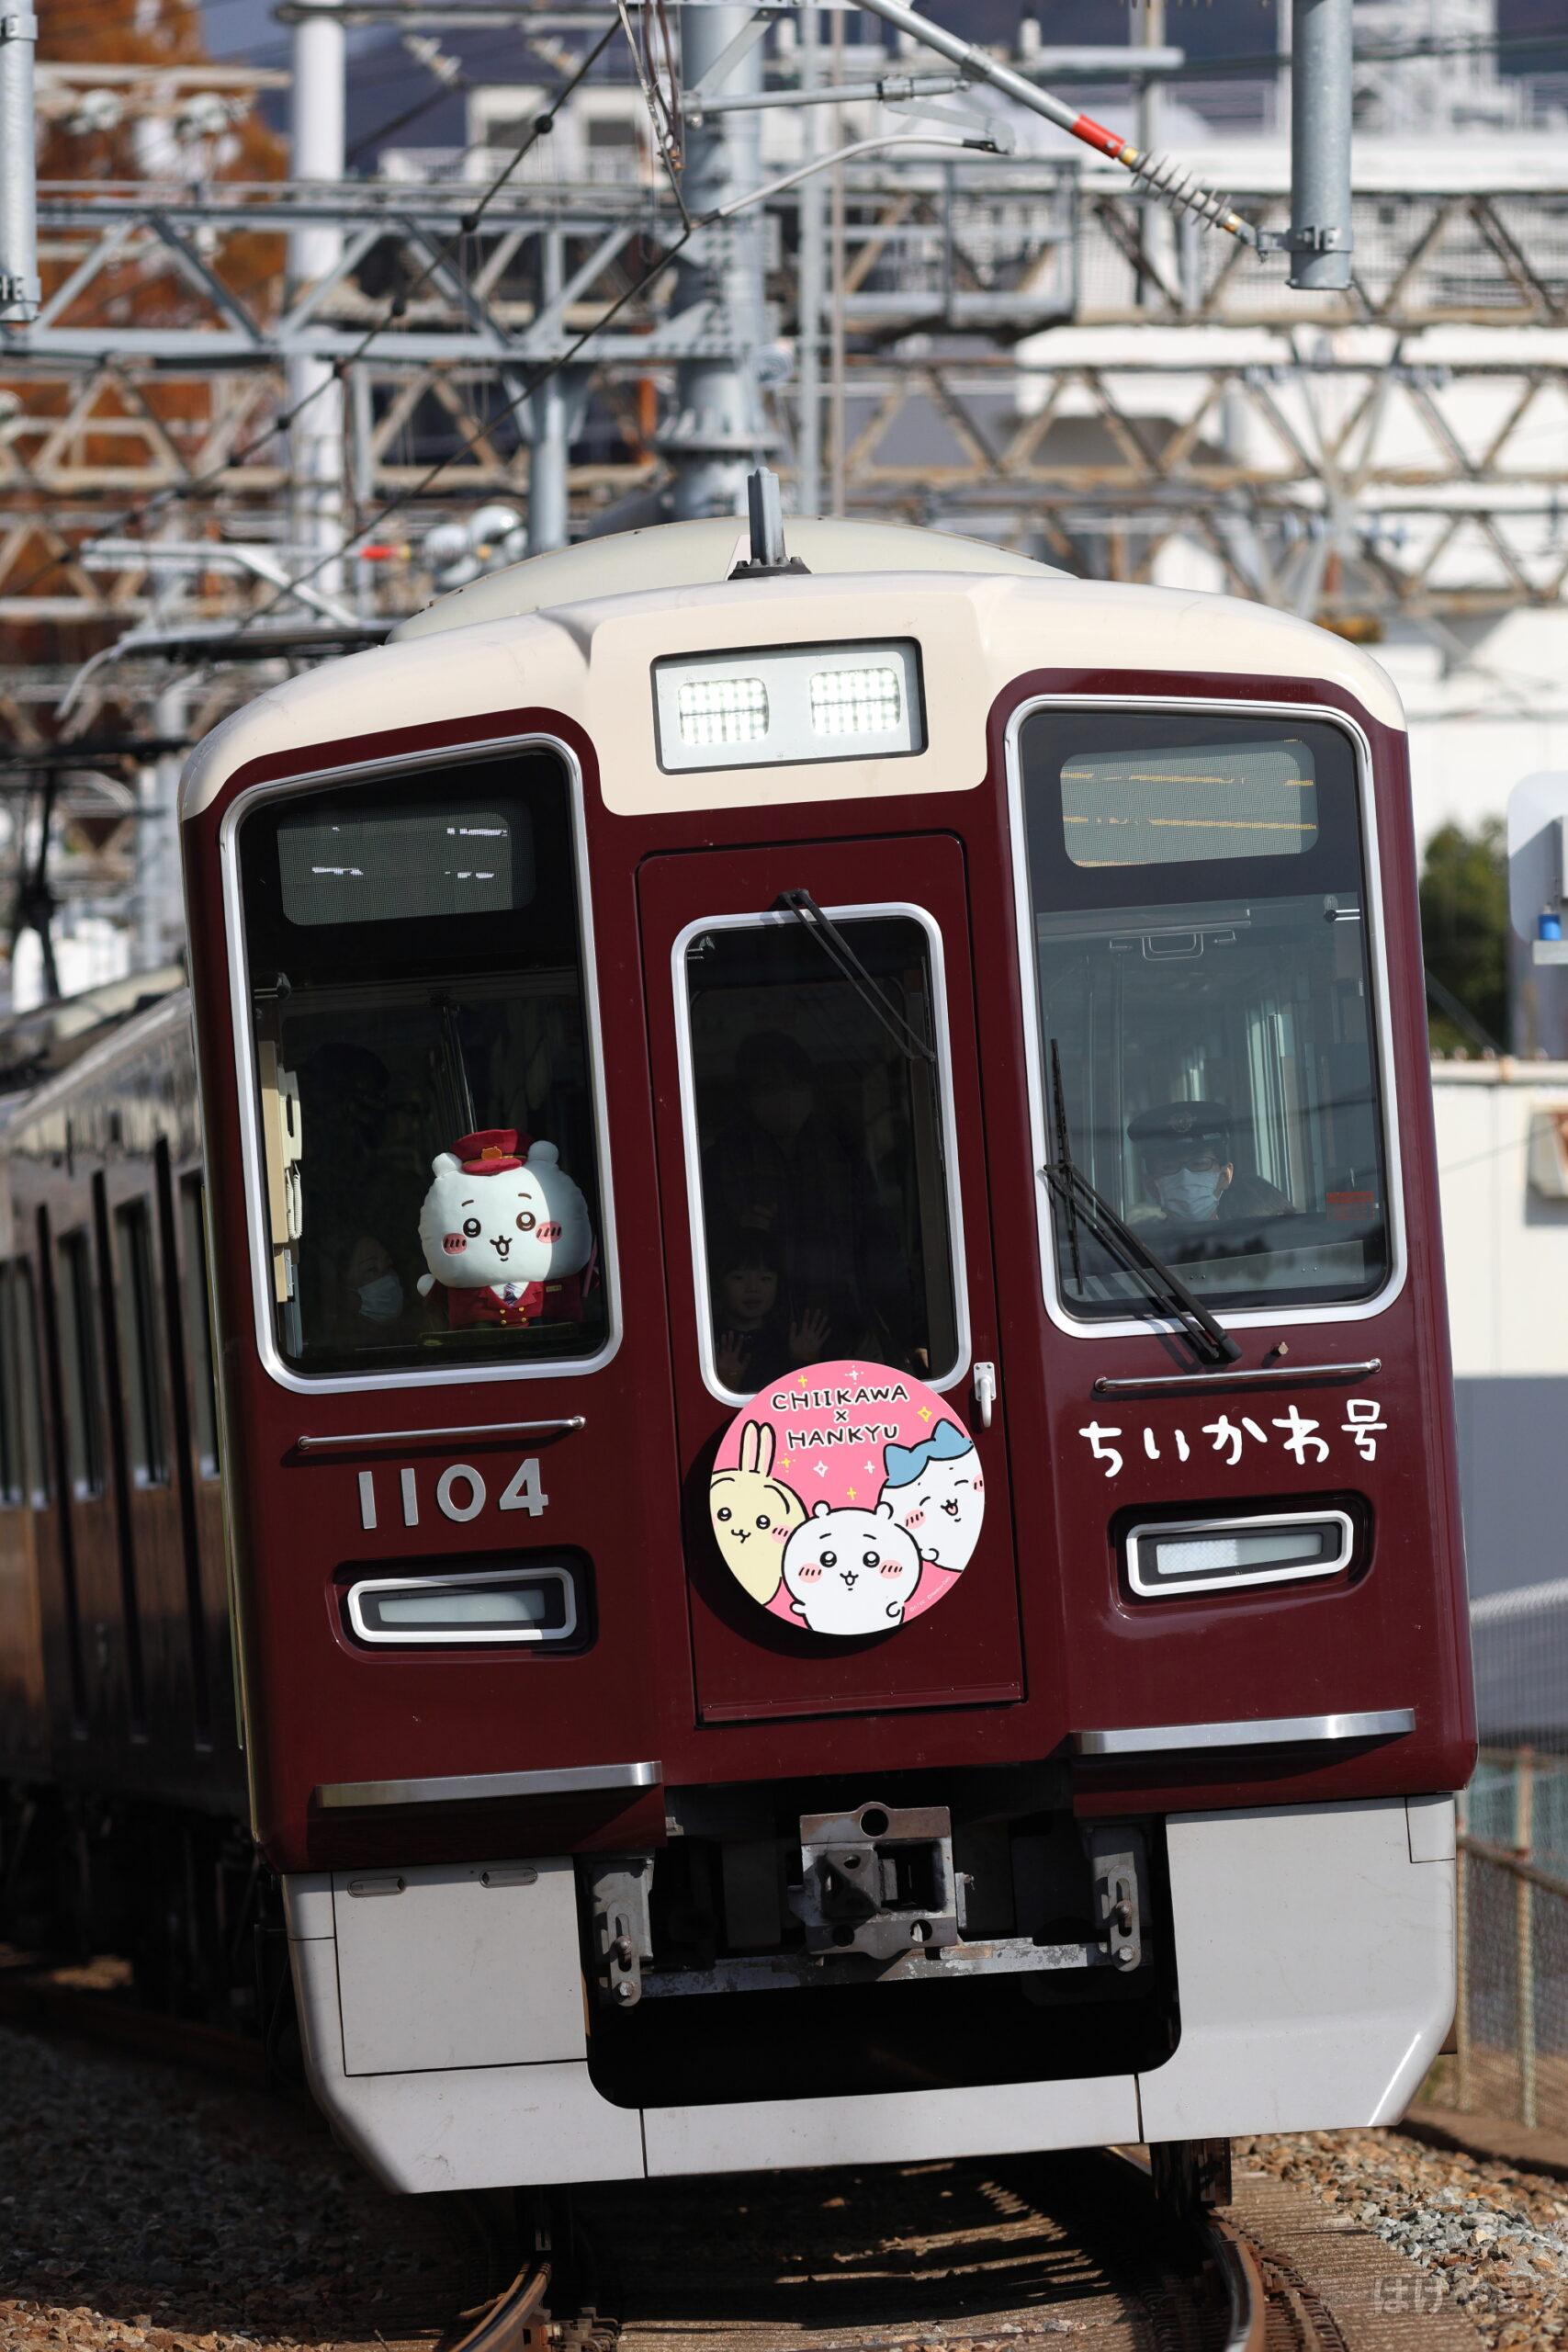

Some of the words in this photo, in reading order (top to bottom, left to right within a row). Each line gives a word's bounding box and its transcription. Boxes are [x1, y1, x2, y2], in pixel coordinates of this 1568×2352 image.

[772, 1385, 908, 1409] CHIIKAWA
[787, 1425, 898, 1449] HANKYU
[1078, 1398, 1388, 1478] ちいかわ号
[358, 1457, 549, 1530] 1104
